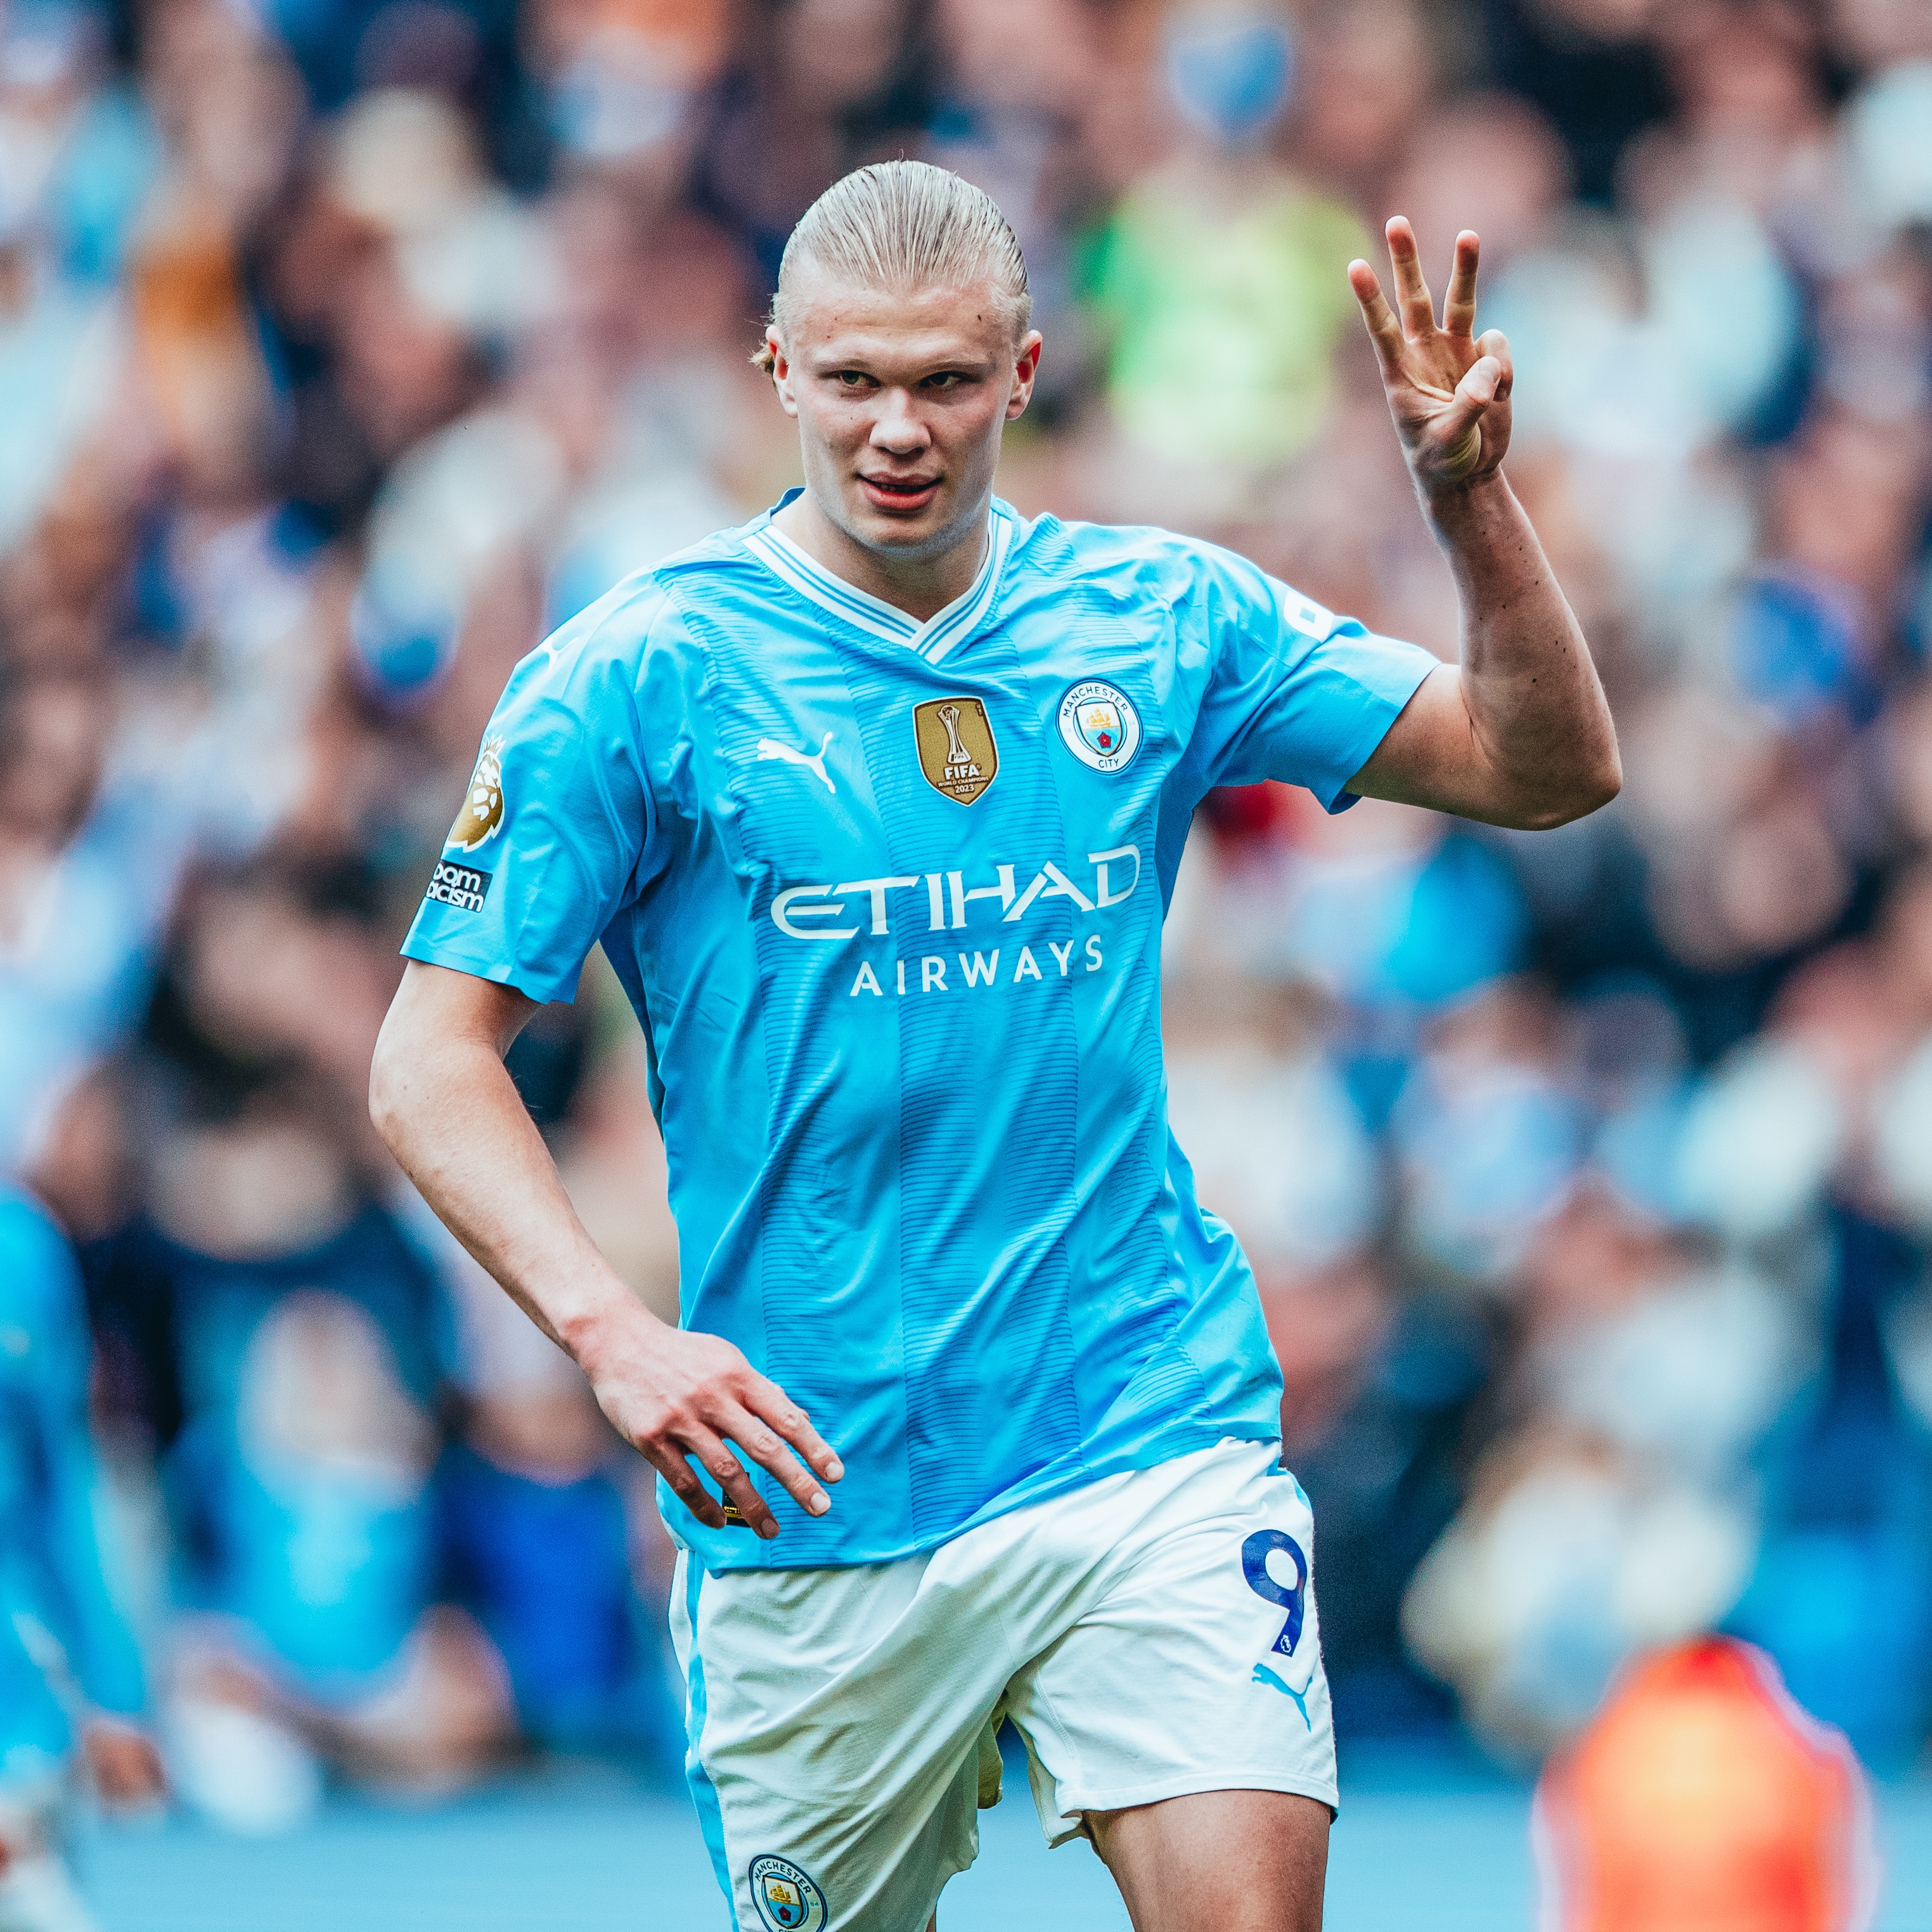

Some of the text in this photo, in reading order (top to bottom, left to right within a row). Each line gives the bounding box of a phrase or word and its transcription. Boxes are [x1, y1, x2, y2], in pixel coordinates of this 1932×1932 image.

[1063, 686, 1128, 718] MANCHESTER
[944, 764, 980, 780] FIFA
[1098, 759, 1119, 768] CITY
[955, 784, 975, 794] 2023
[958, 776, 989, 785] CHAMPIONS
[770, 844, 1141, 940] ETIHAD
[849, 934, 1104, 997] AIRWAYS
[1241, 1529, 1308, 1658] 9
[754, 1861, 811, 1894] MANCHESTER
